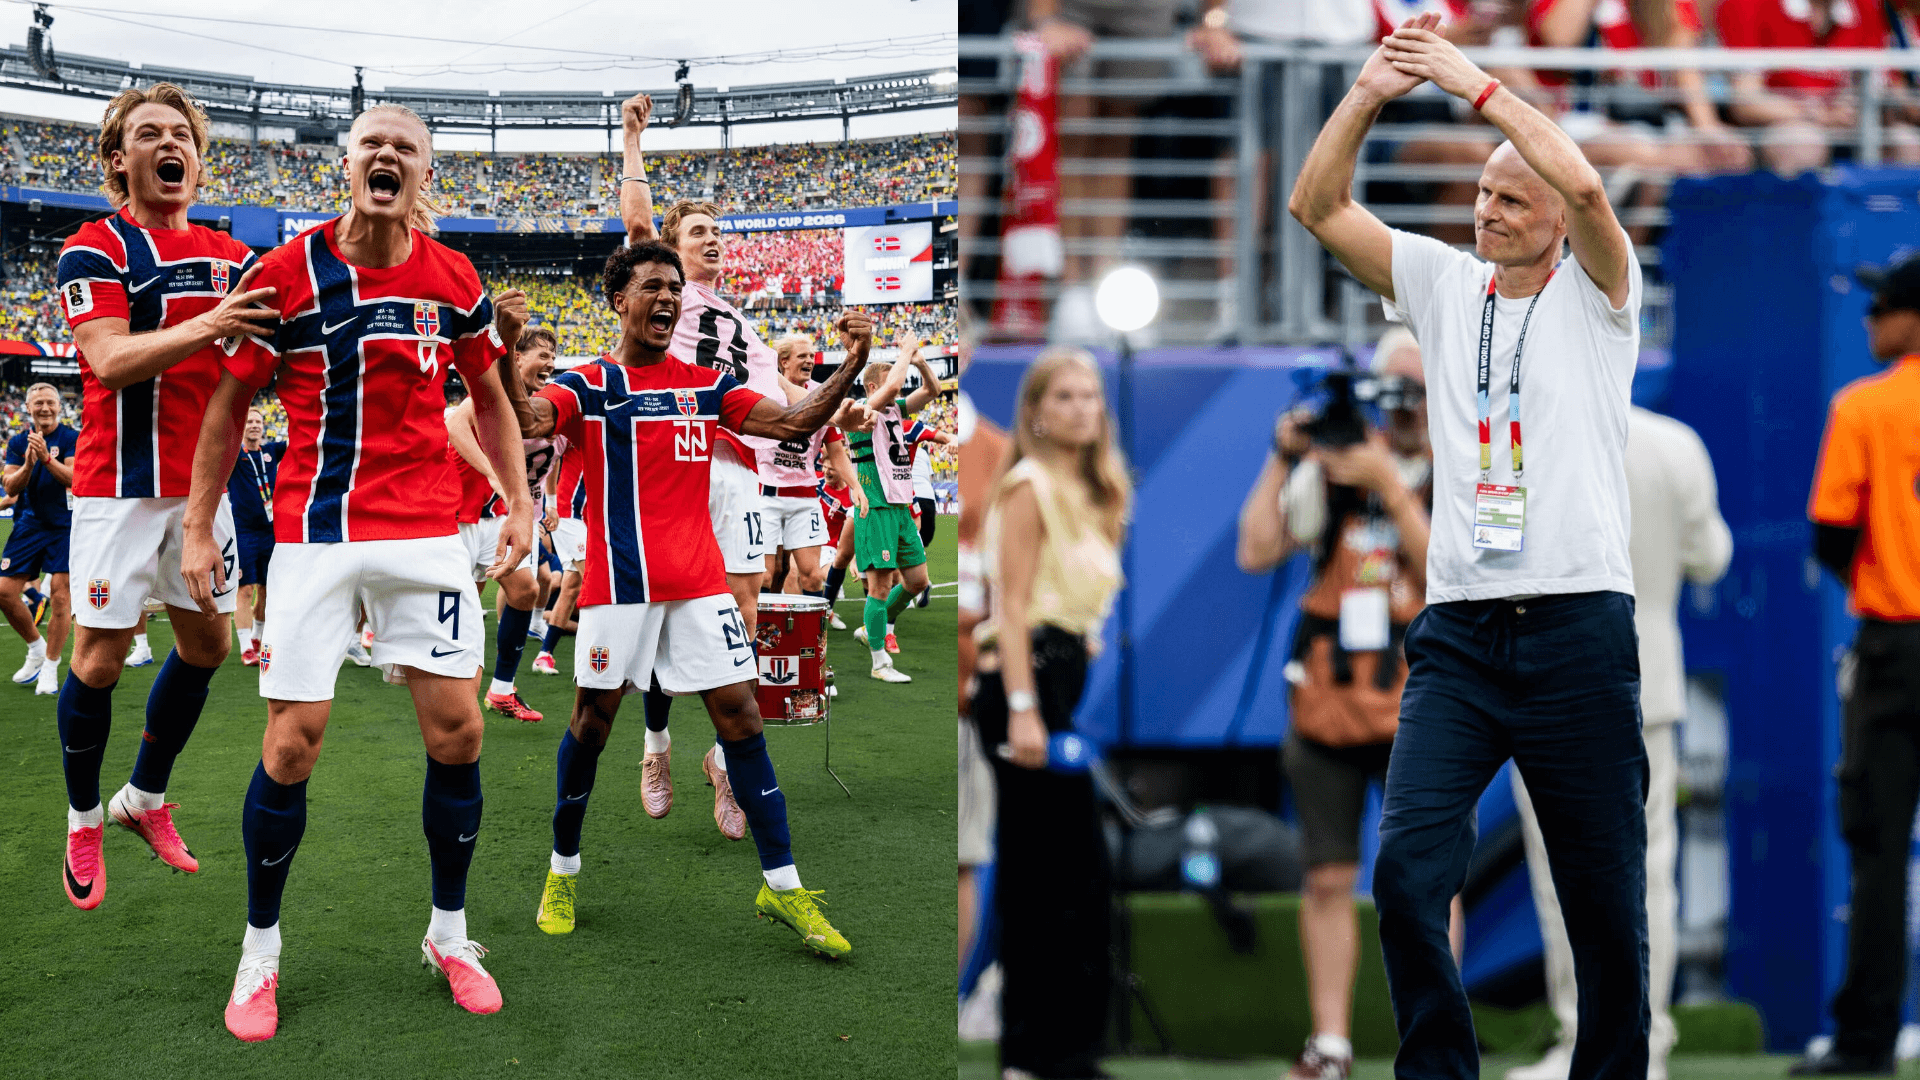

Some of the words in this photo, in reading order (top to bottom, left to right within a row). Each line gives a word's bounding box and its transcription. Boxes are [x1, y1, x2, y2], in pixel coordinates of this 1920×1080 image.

[734, 218, 777, 230] WORLD
[778, 216, 802, 228] CUP
[803, 214, 846, 226] 2026
[865, 256, 911, 271] NORWAY
[1484, 300, 1493, 325] 2026
[1482, 324, 1491, 340] CUP
[1480, 340, 1489, 367] WORLD
[1480, 367, 1488, 384] FIFA
[673, 420, 709, 462] 22
[787, 442, 803, 450] FIFA
[773, 457, 806, 470] 2026
[775, 452, 798, 460] WORLD
[892, 472, 912, 481] 202
[810, 512, 820, 532] 2
[221, 536, 235, 581] 6
[437, 590, 462, 641] 9
